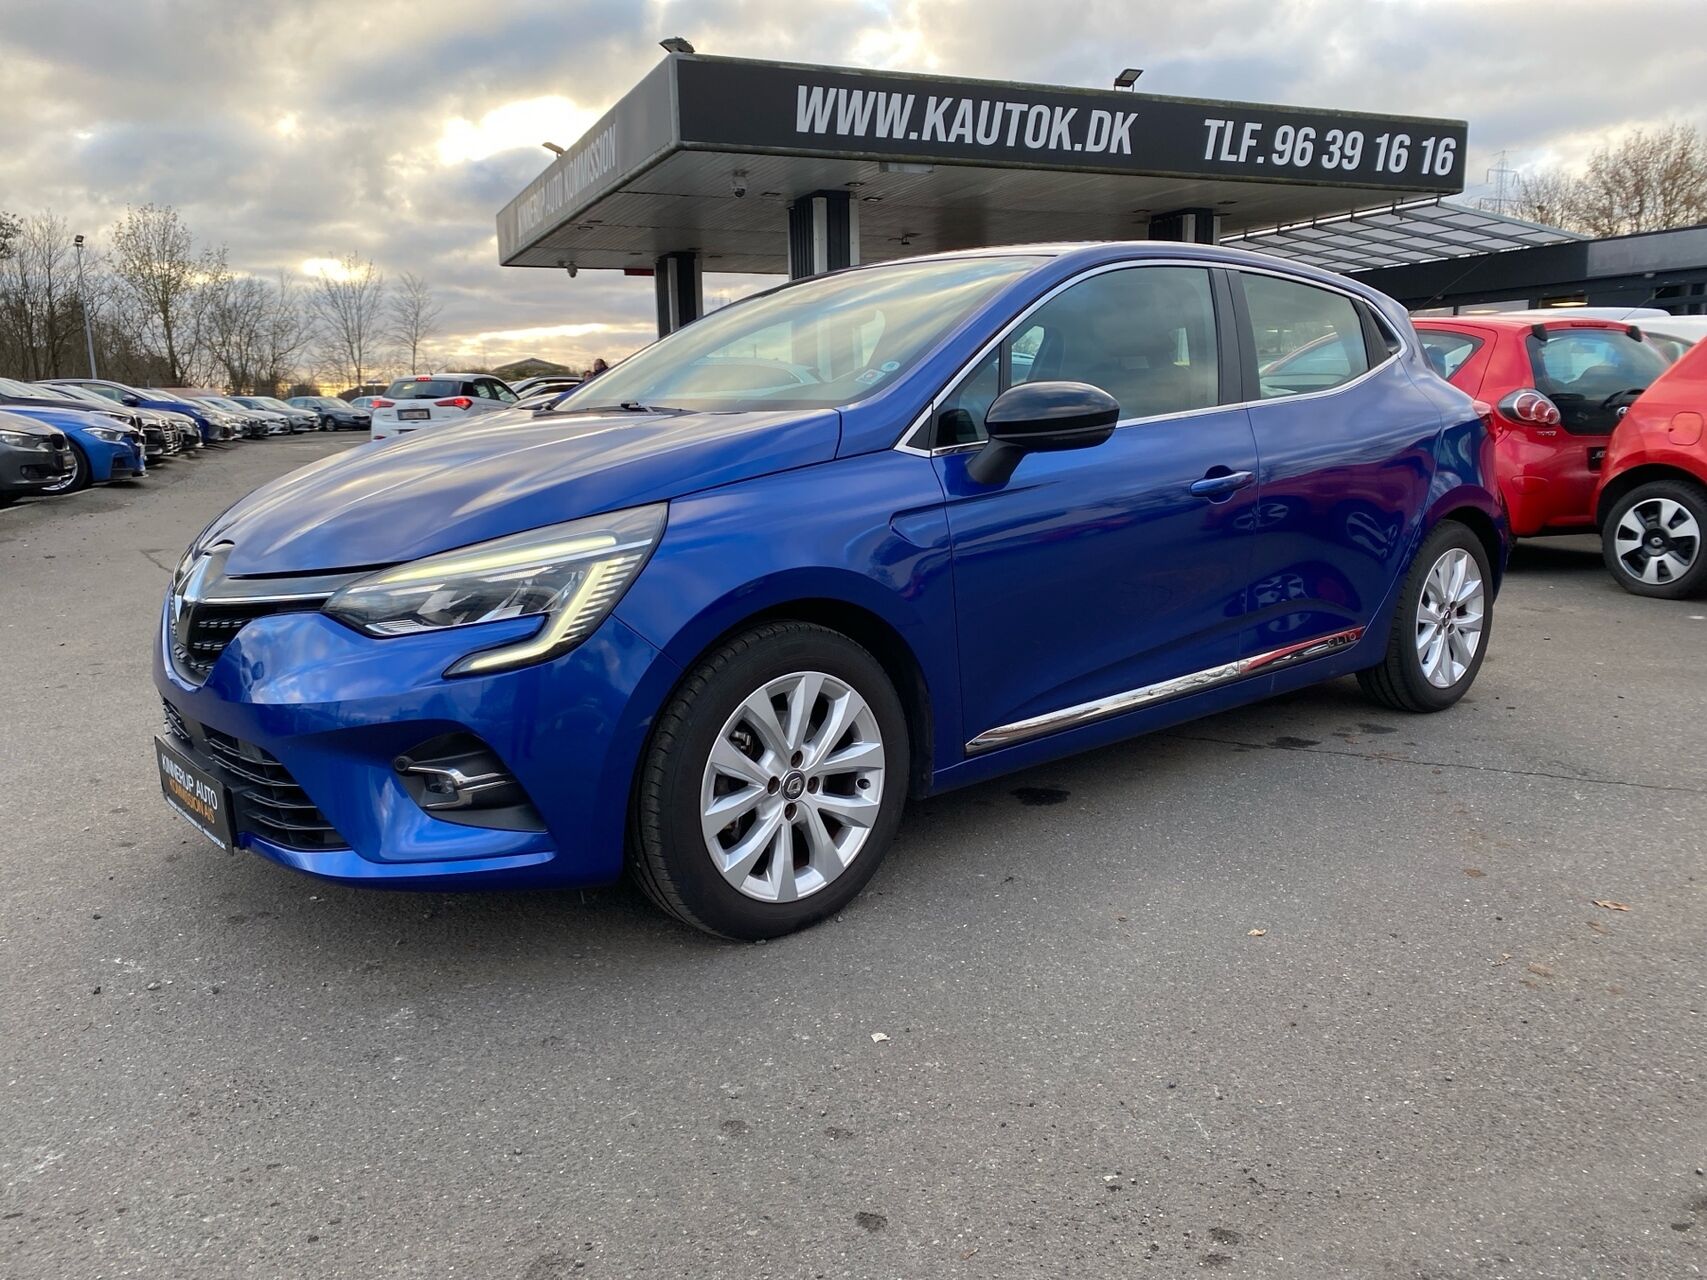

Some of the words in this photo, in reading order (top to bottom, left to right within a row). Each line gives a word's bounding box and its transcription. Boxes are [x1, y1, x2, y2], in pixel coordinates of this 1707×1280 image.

[796, 85, 1139, 155] WWW.KAUTOK.DK
[1204, 118, 1265, 164] TLF.
[1271, 125, 1317, 167] 96
[1321, 129, 1365, 171] 39
[1375, 133, 1411, 173] 16
[1420, 136, 1457, 176] 16
[1328, 633, 1356, 647] CLIO
[196, 779, 218, 811] AUTO
